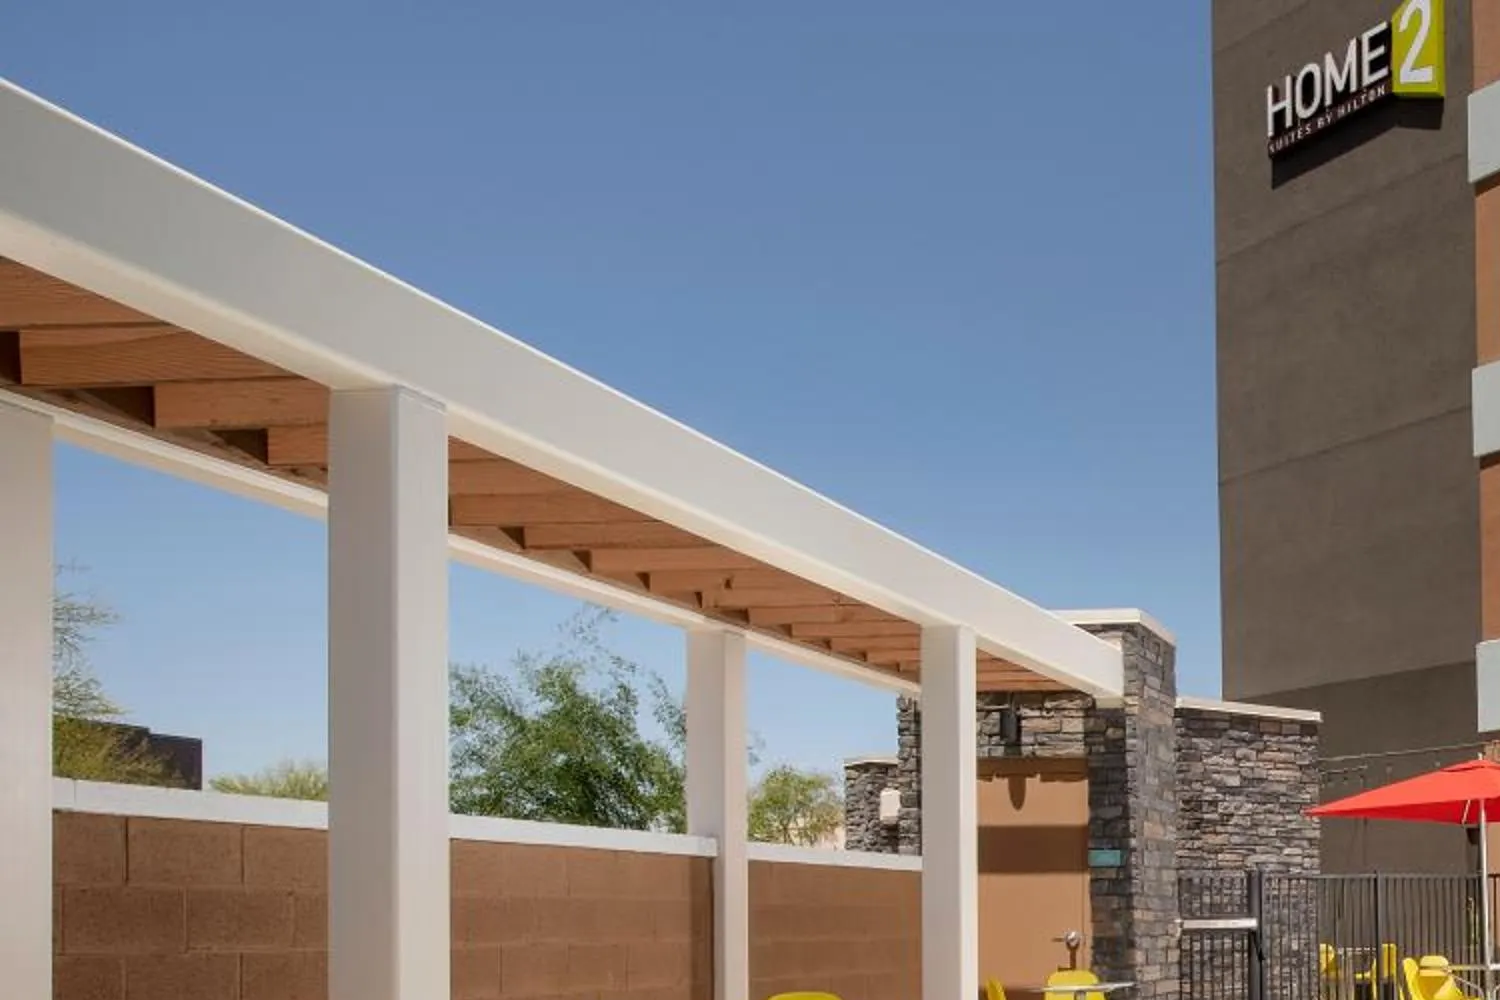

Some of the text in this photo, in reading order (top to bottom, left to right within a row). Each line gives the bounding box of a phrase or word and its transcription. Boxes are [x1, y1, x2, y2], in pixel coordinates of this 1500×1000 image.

[1267, 0, 1433, 137] HOME 2
[1268, 84, 1386, 153] SUITES BY HILTON
